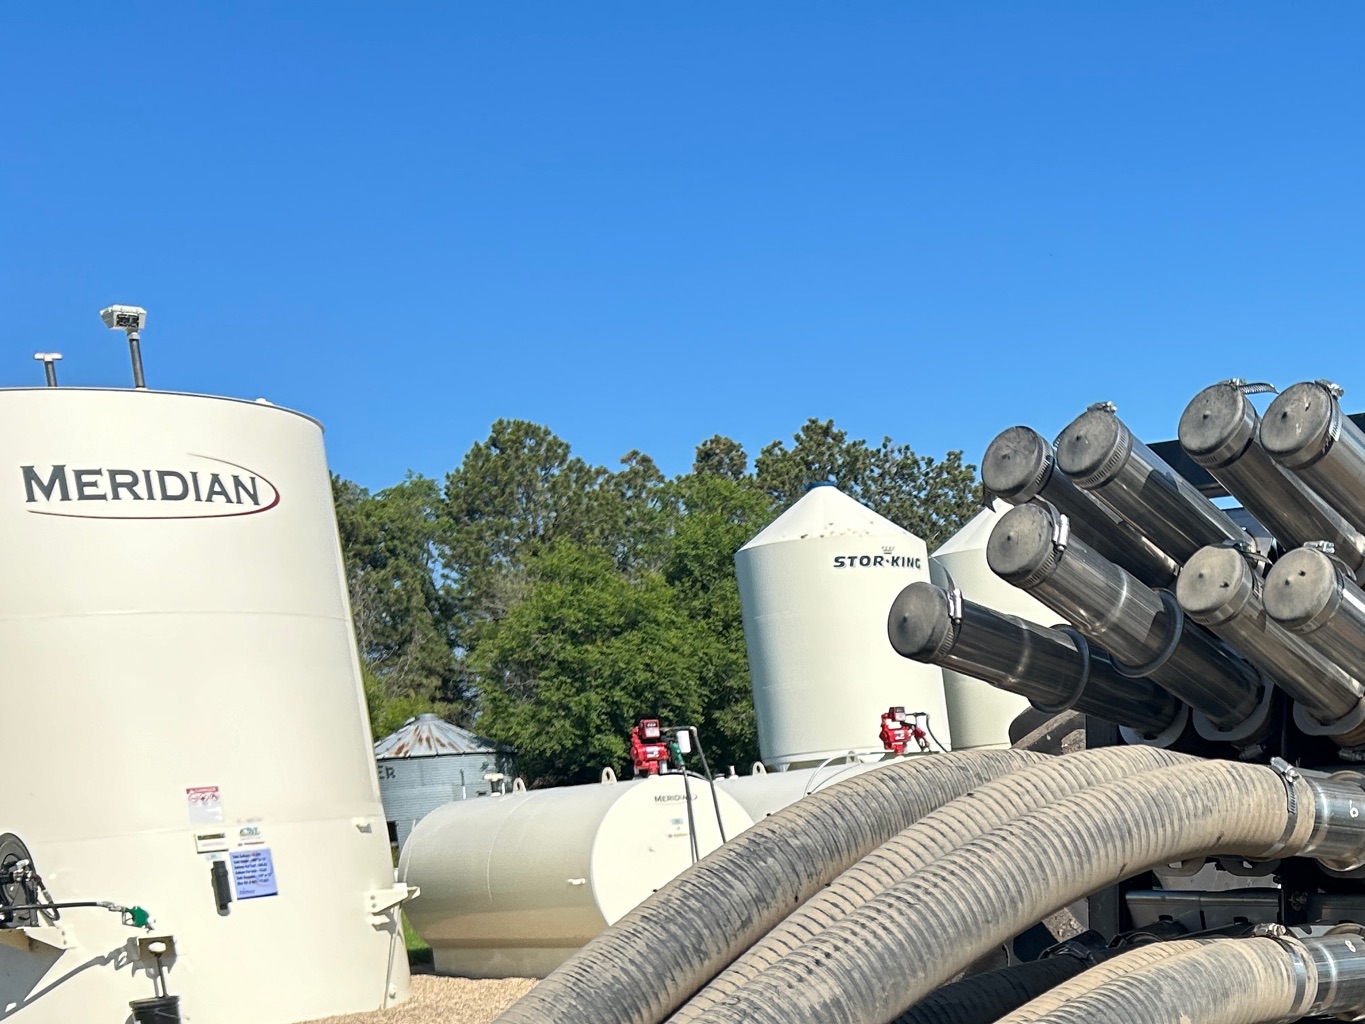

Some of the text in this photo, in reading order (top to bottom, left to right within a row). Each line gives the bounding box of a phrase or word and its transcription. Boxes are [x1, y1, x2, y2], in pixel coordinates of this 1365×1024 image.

[20, 464, 261, 506] MERIDIAN
[654, 794, 689, 803] MERIDIA
[1349, 799, 1359, 818] 6
[1344, 940, 1357, 953] 8
